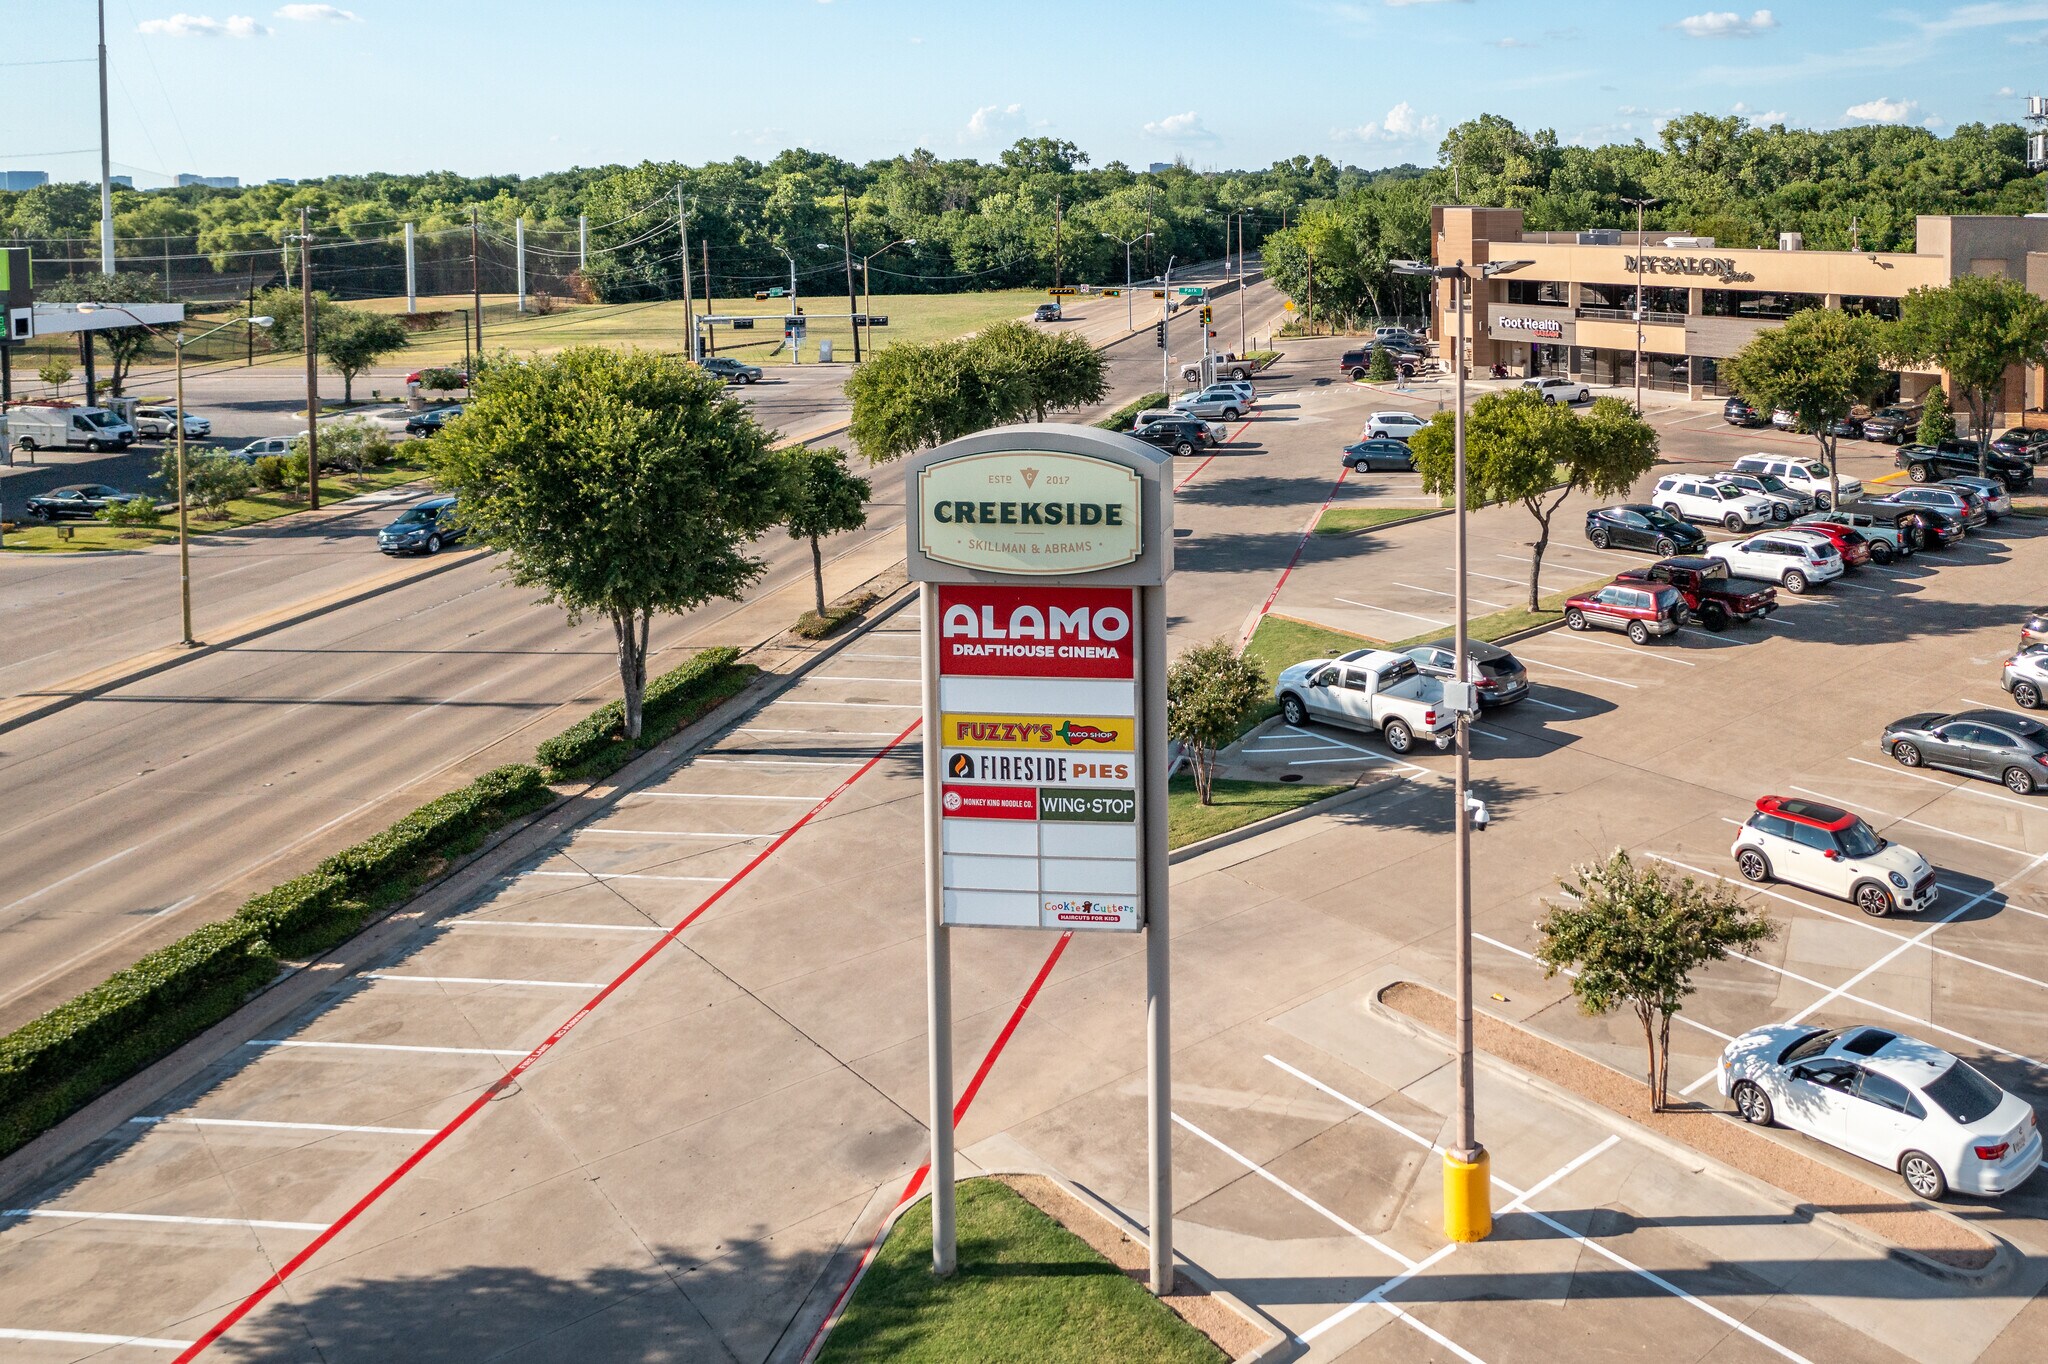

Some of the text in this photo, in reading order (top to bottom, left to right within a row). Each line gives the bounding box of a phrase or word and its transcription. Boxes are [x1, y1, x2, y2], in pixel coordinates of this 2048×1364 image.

[1624, 255, 1734, 276] MY SALON
[1499, 316, 1559, 330] Foot Health
[1046, 475, 1070, 485] 2017
[934, 500, 1123, 526] CREEKSIDE
[968, 539, 1092, 554] SKILLMAN & ABRAMS
[943, 604, 1130, 642] ALAMO
[953, 644, 1119, 659] DRAFTHOUSE CINEMA
[957, 722, 1053, 742] FUZZY'S
[981, 755, 1129, 782] FIRESIDE PIES
[963, 798, 1033, 808] MONKEY KING NOODLE CO.
[1044, 901, 1134, 913] Cookie Cutters
